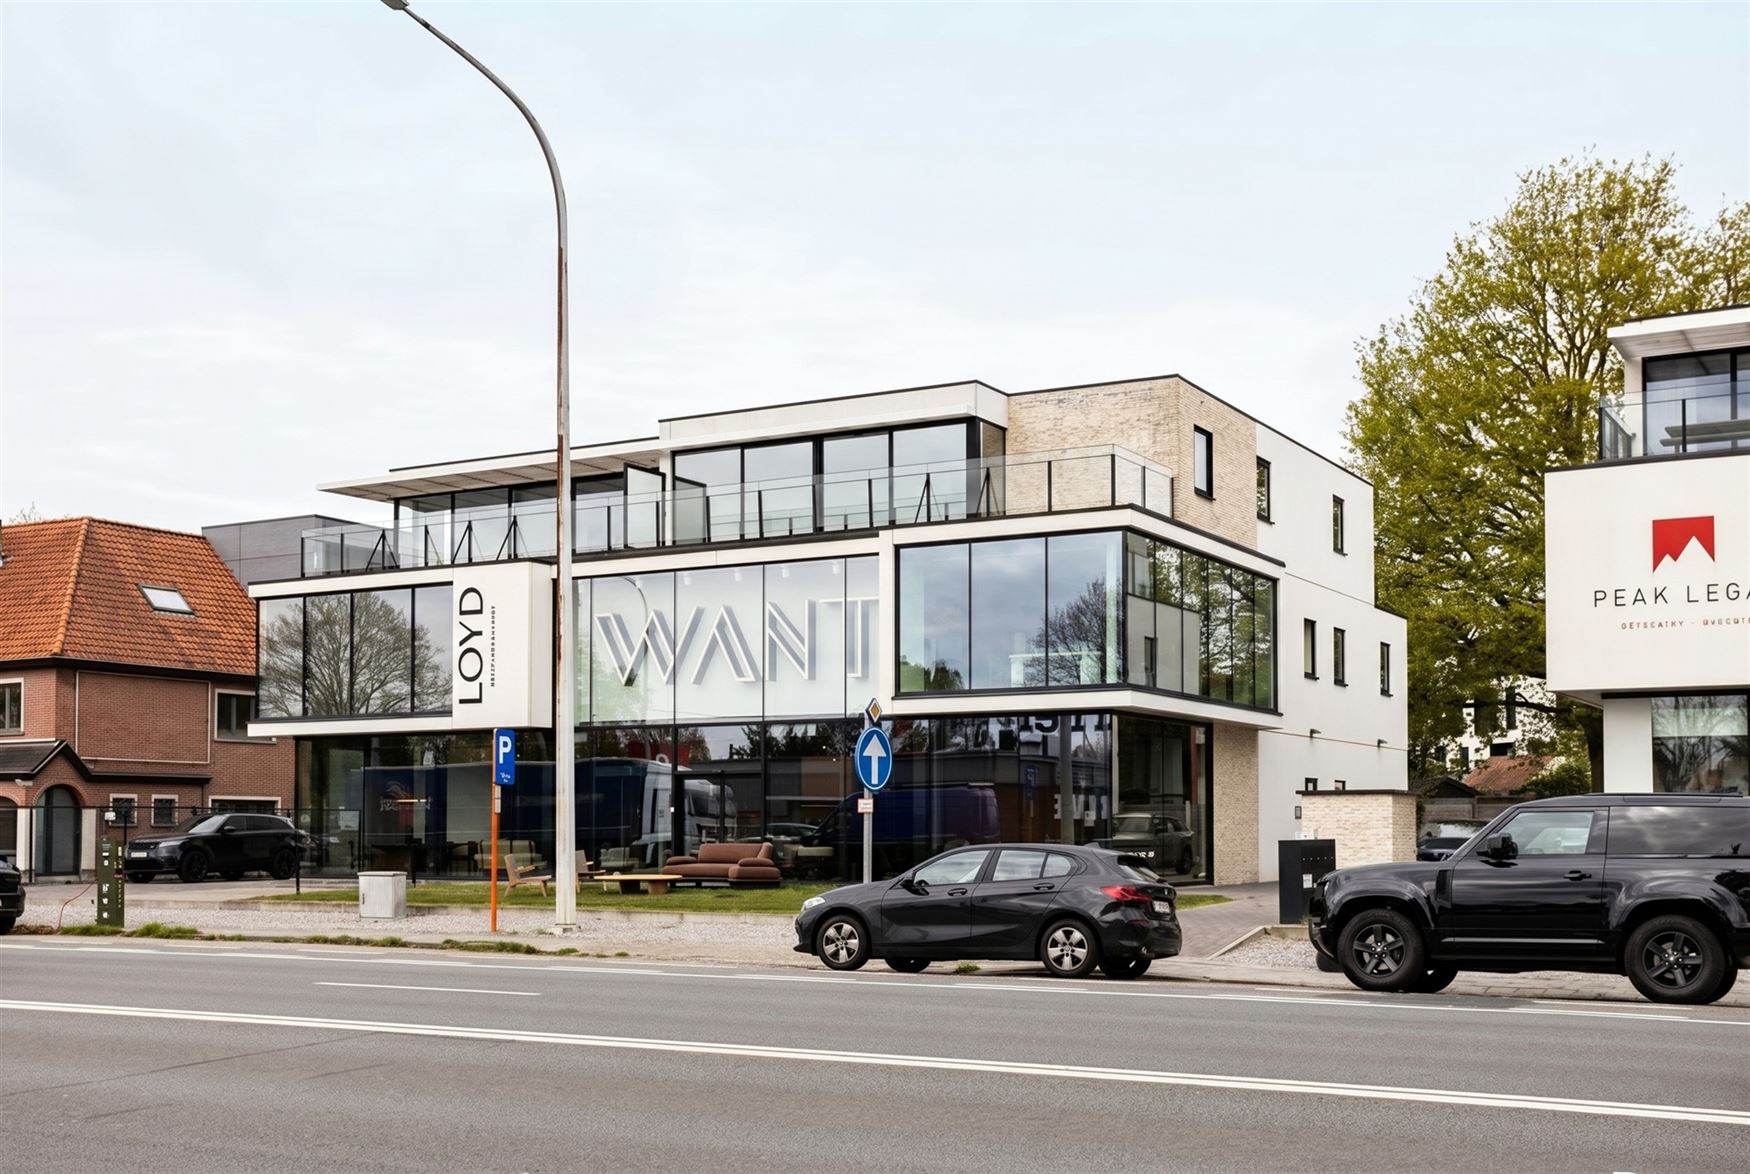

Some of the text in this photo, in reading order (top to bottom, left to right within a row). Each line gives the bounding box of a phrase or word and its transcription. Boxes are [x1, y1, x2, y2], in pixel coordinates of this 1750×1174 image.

[1594, 586, 1668, 608] PEAK
[457, 586, 484, 704] LOYD
[595, 597, 880, 687] WANT
[499, 735, 512, 764] P
